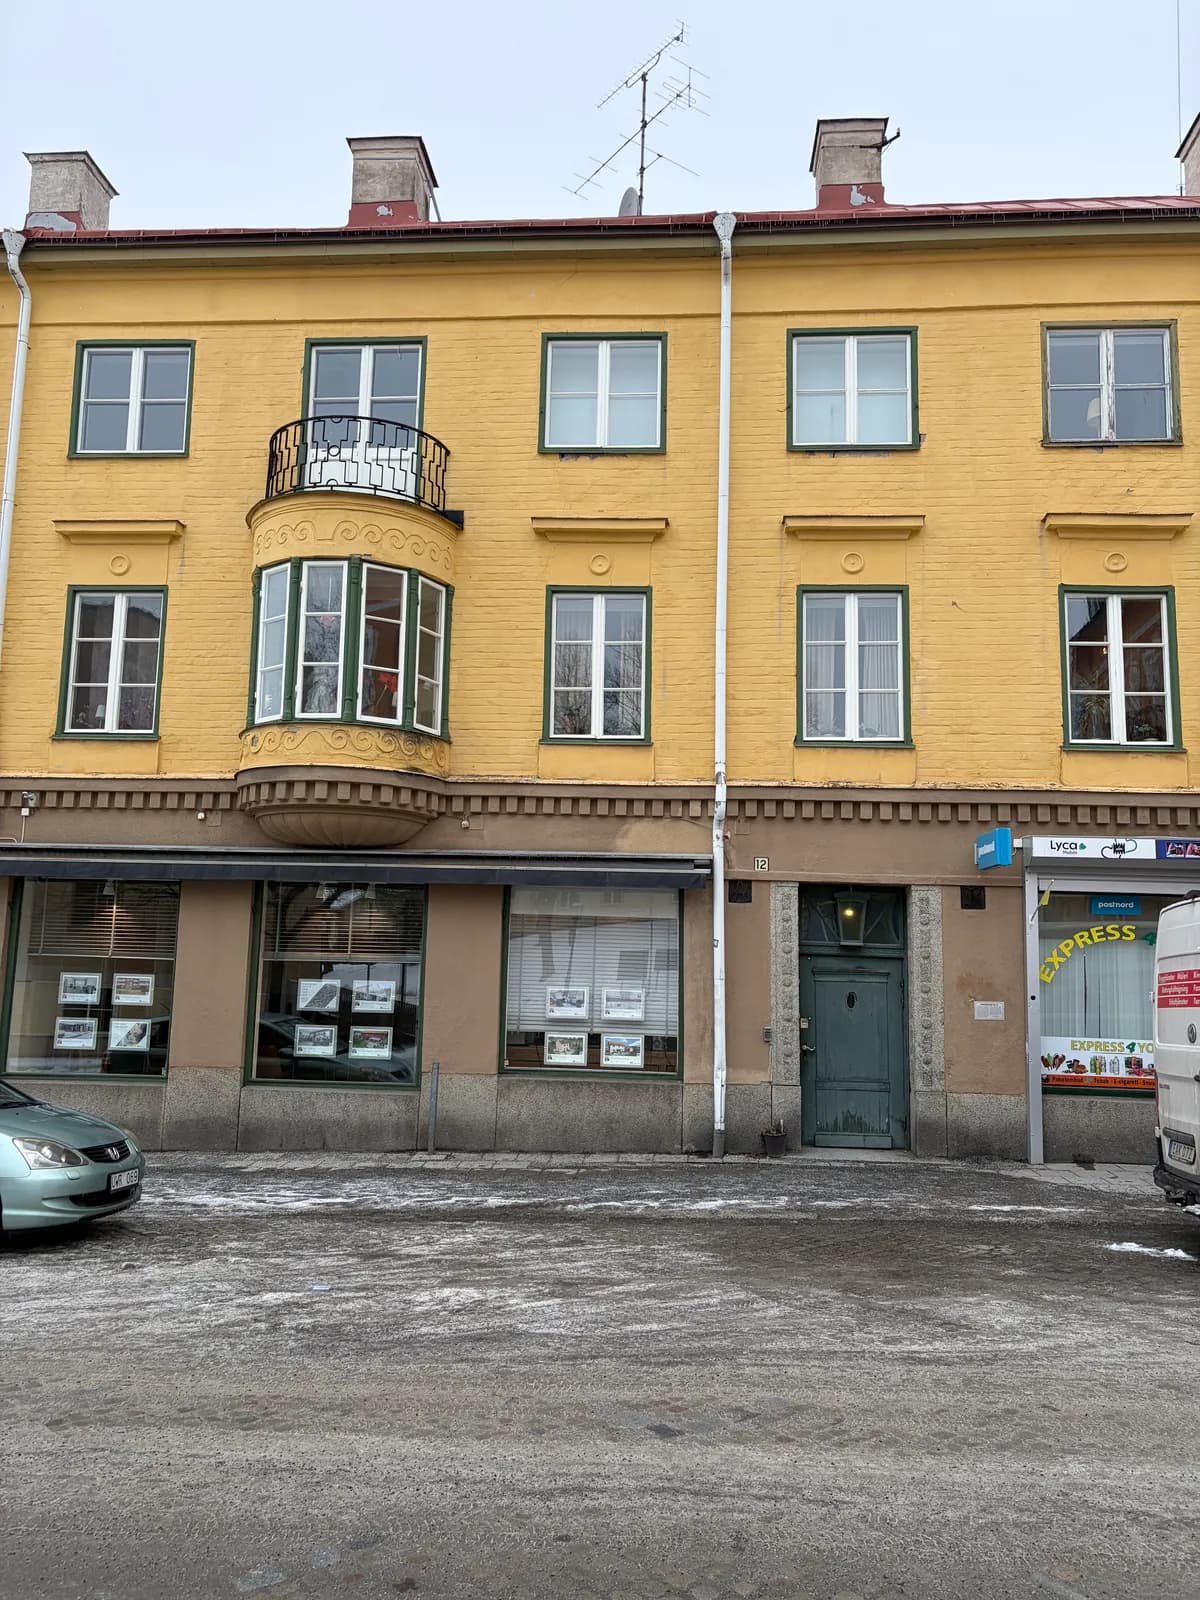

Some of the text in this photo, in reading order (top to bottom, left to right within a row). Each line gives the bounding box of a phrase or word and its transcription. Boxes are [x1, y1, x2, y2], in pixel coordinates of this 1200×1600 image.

[1050, 839, 1078, 852] Lyca
[756, 859, 767, 870] 12
[1039, 924, 1136, 984] EXPRESS
[1070, 1040, 1125, 1052] EXPRESS
[1126, 1041, 1137, 1053] 4
